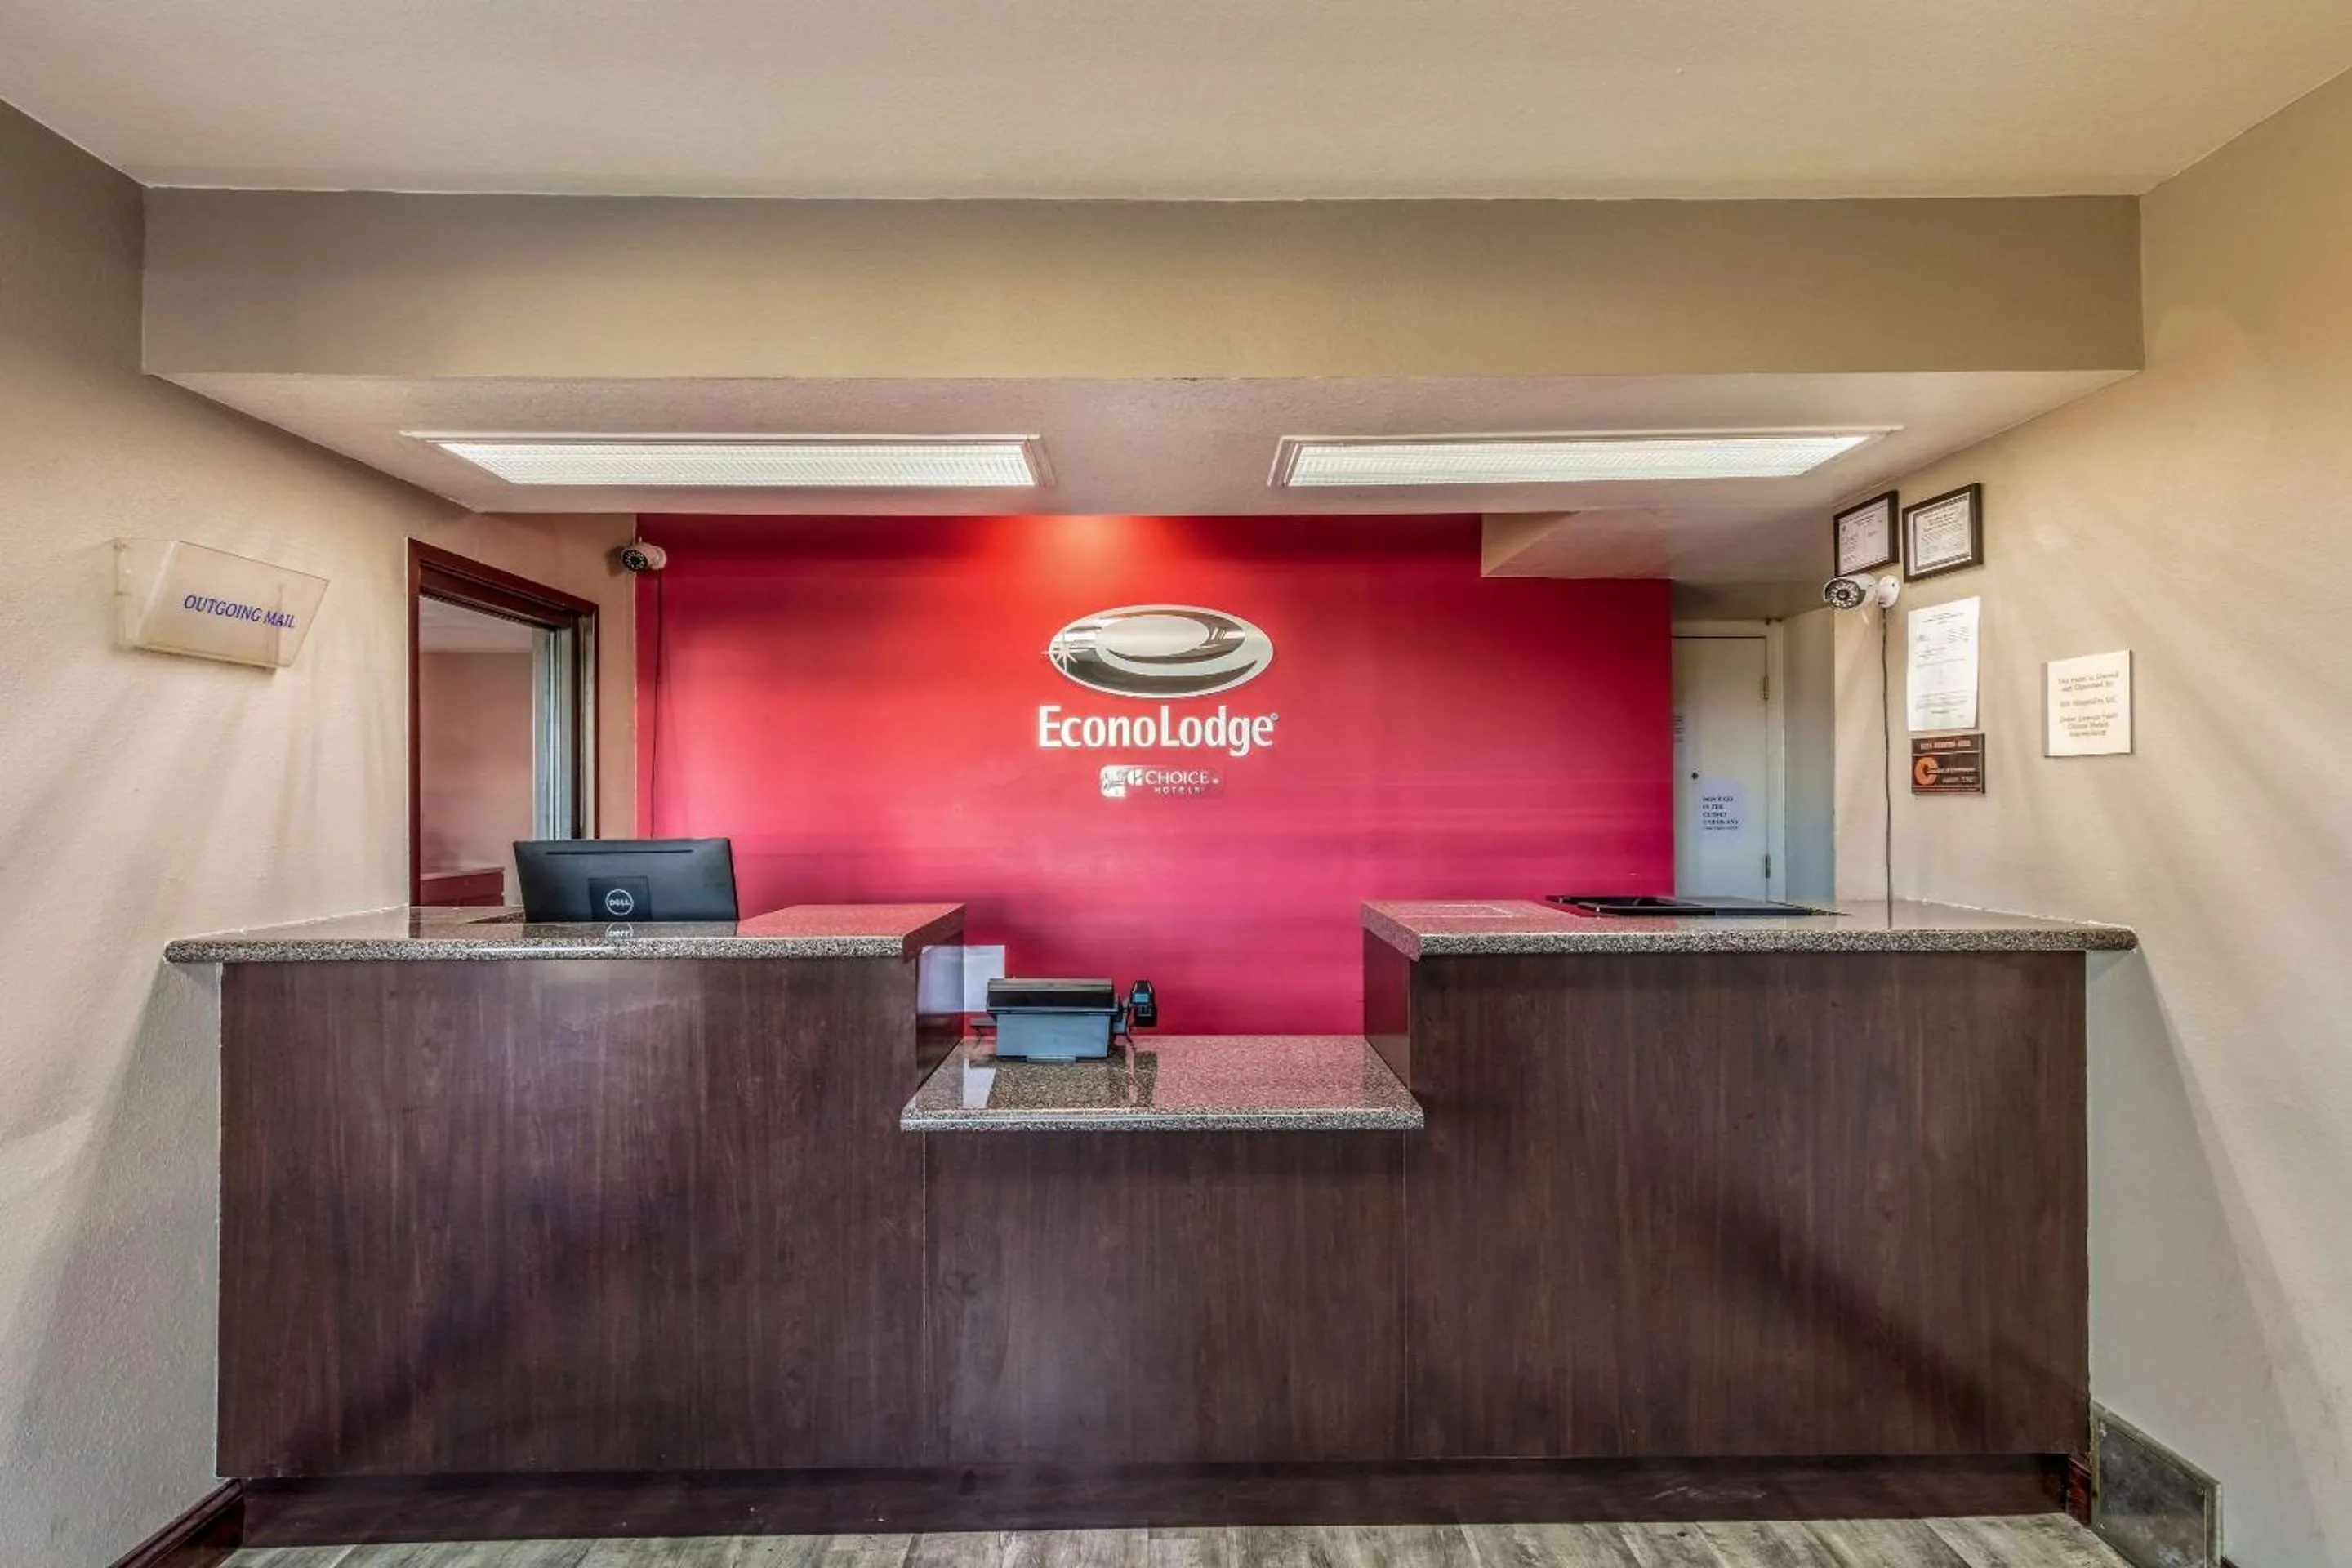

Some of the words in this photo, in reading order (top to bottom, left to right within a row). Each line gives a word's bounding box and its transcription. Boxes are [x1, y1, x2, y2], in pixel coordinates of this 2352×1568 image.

[184, 594, 261, 622] OUTGOING
[262, 610, 296, 628] MAIL
[1038, 705, 1274, 757] EconoLodge
[1145, 770, 1209, 785] CHOICE
[1154, 786, 1200, 795] HOTELS
